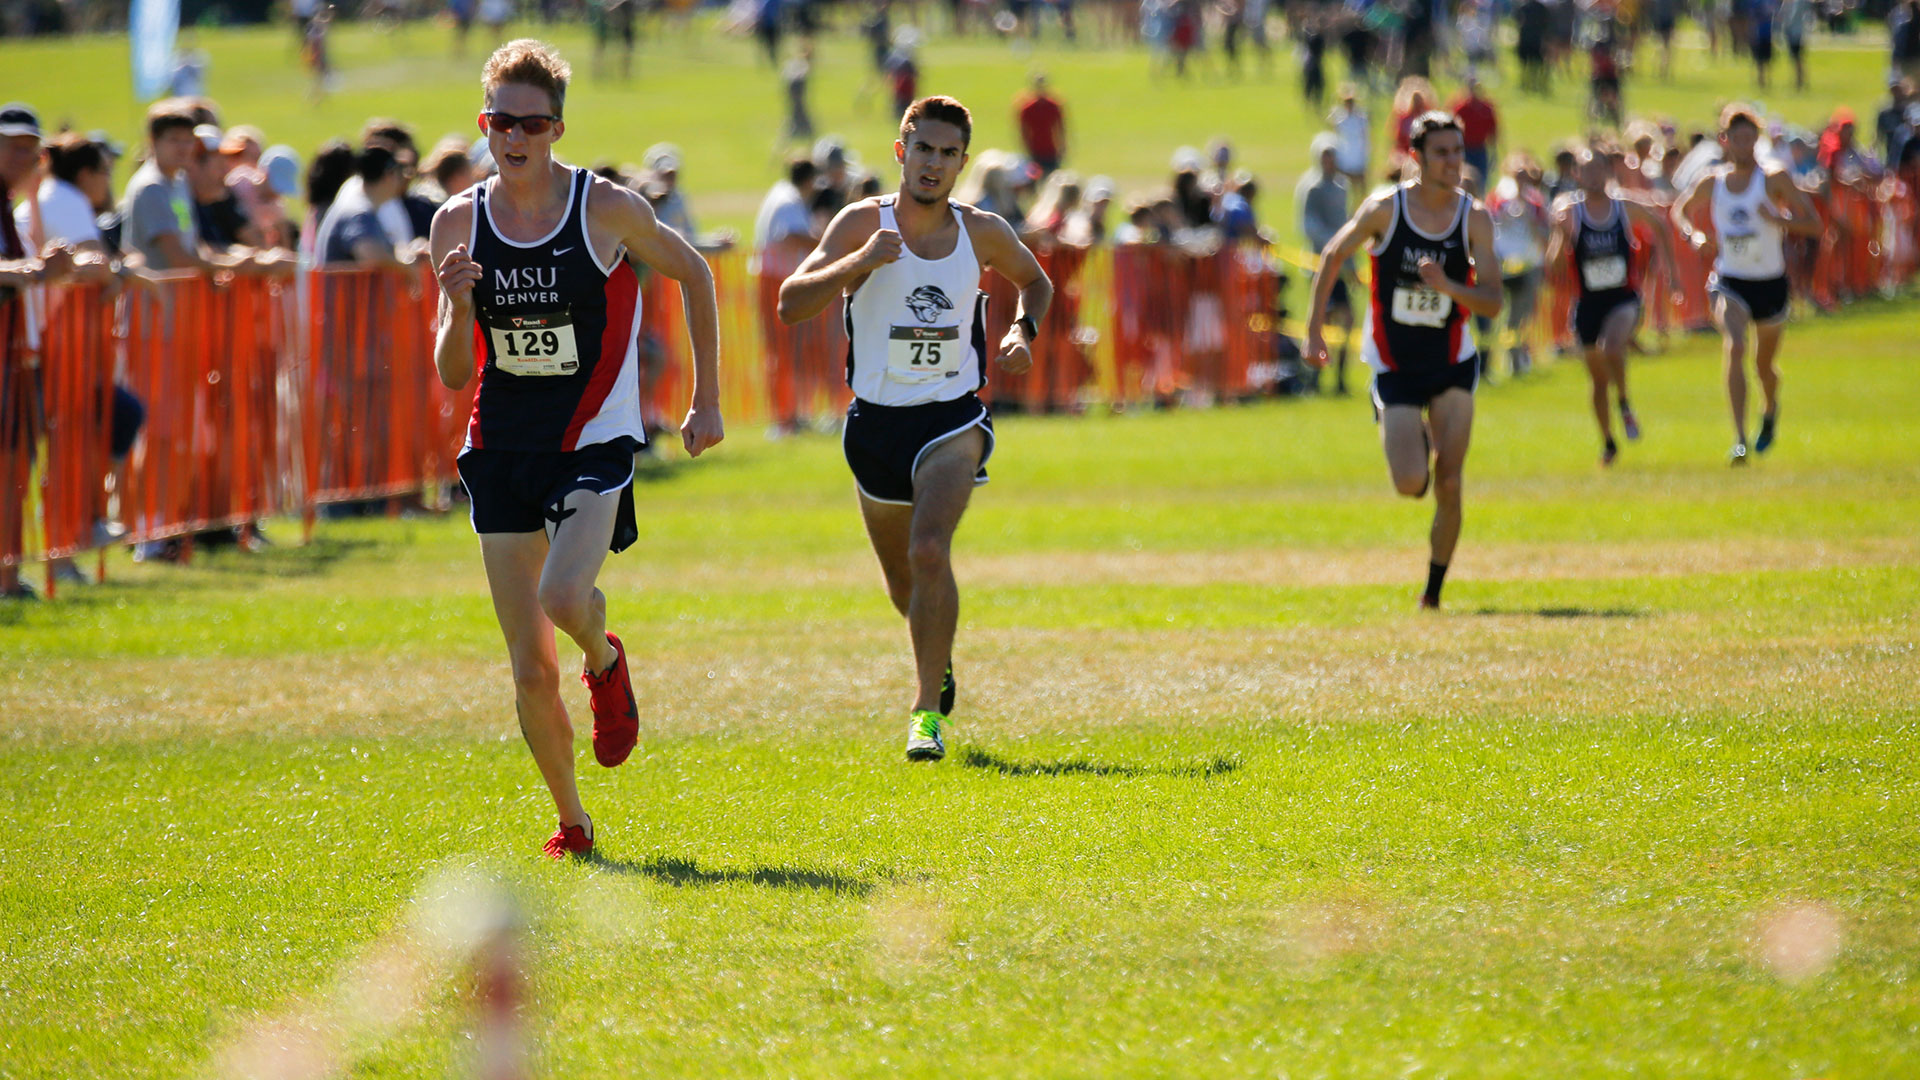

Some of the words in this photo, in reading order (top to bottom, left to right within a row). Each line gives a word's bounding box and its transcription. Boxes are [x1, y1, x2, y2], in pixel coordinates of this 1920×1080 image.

[494, 267, 557, 290] MSU
[495, 292, 559, 306] DENVER
[504, 330, 559, 356] 129
[910, 342, 941, 366] 75
